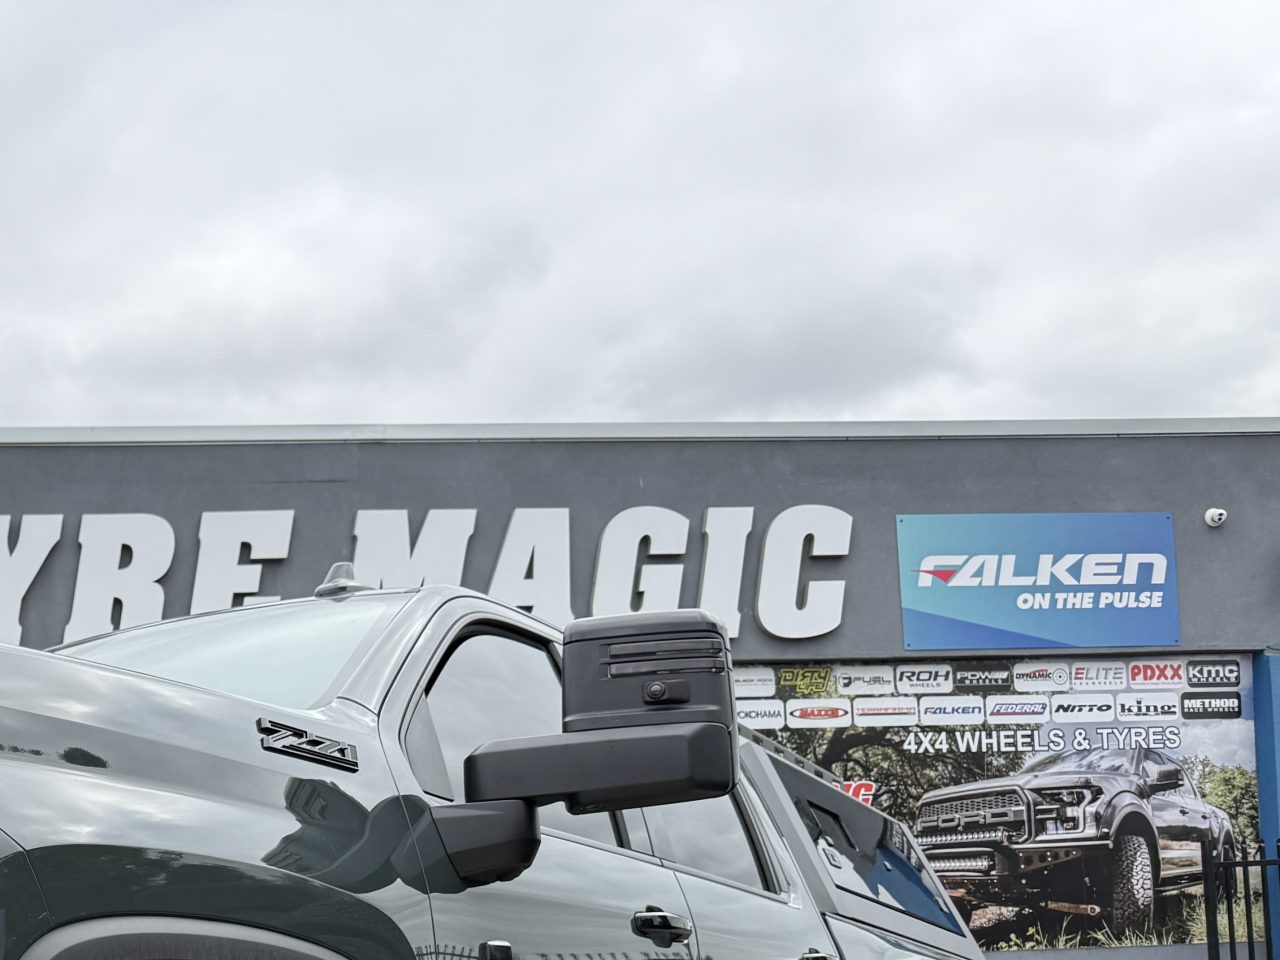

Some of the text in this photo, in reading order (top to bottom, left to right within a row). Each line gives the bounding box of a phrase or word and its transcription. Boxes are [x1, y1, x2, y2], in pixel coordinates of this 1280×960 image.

[352, 504, 854, 638] MAGIC
[912, 553, 1168, 587] FALKEN
[1016, 591, 1163, 610] ON THE PULSE
[899, 670, 951, 682] ROH
[1015, 671, 1053, 680] DYNAMIC
[1073, 667, 1125, 681] ELITE
[1130, 664, 1183, 681] PDXX
[993, 703, 1045, 713] FEDERAL
[1054, 704, 1113, 713] NITTO
[1183, 698, 1239, 708] METHOD
[924, 706, 982, 715] FALKEN
[902, 726, 1182, 754] 4X4 WHEELS & TYRES
